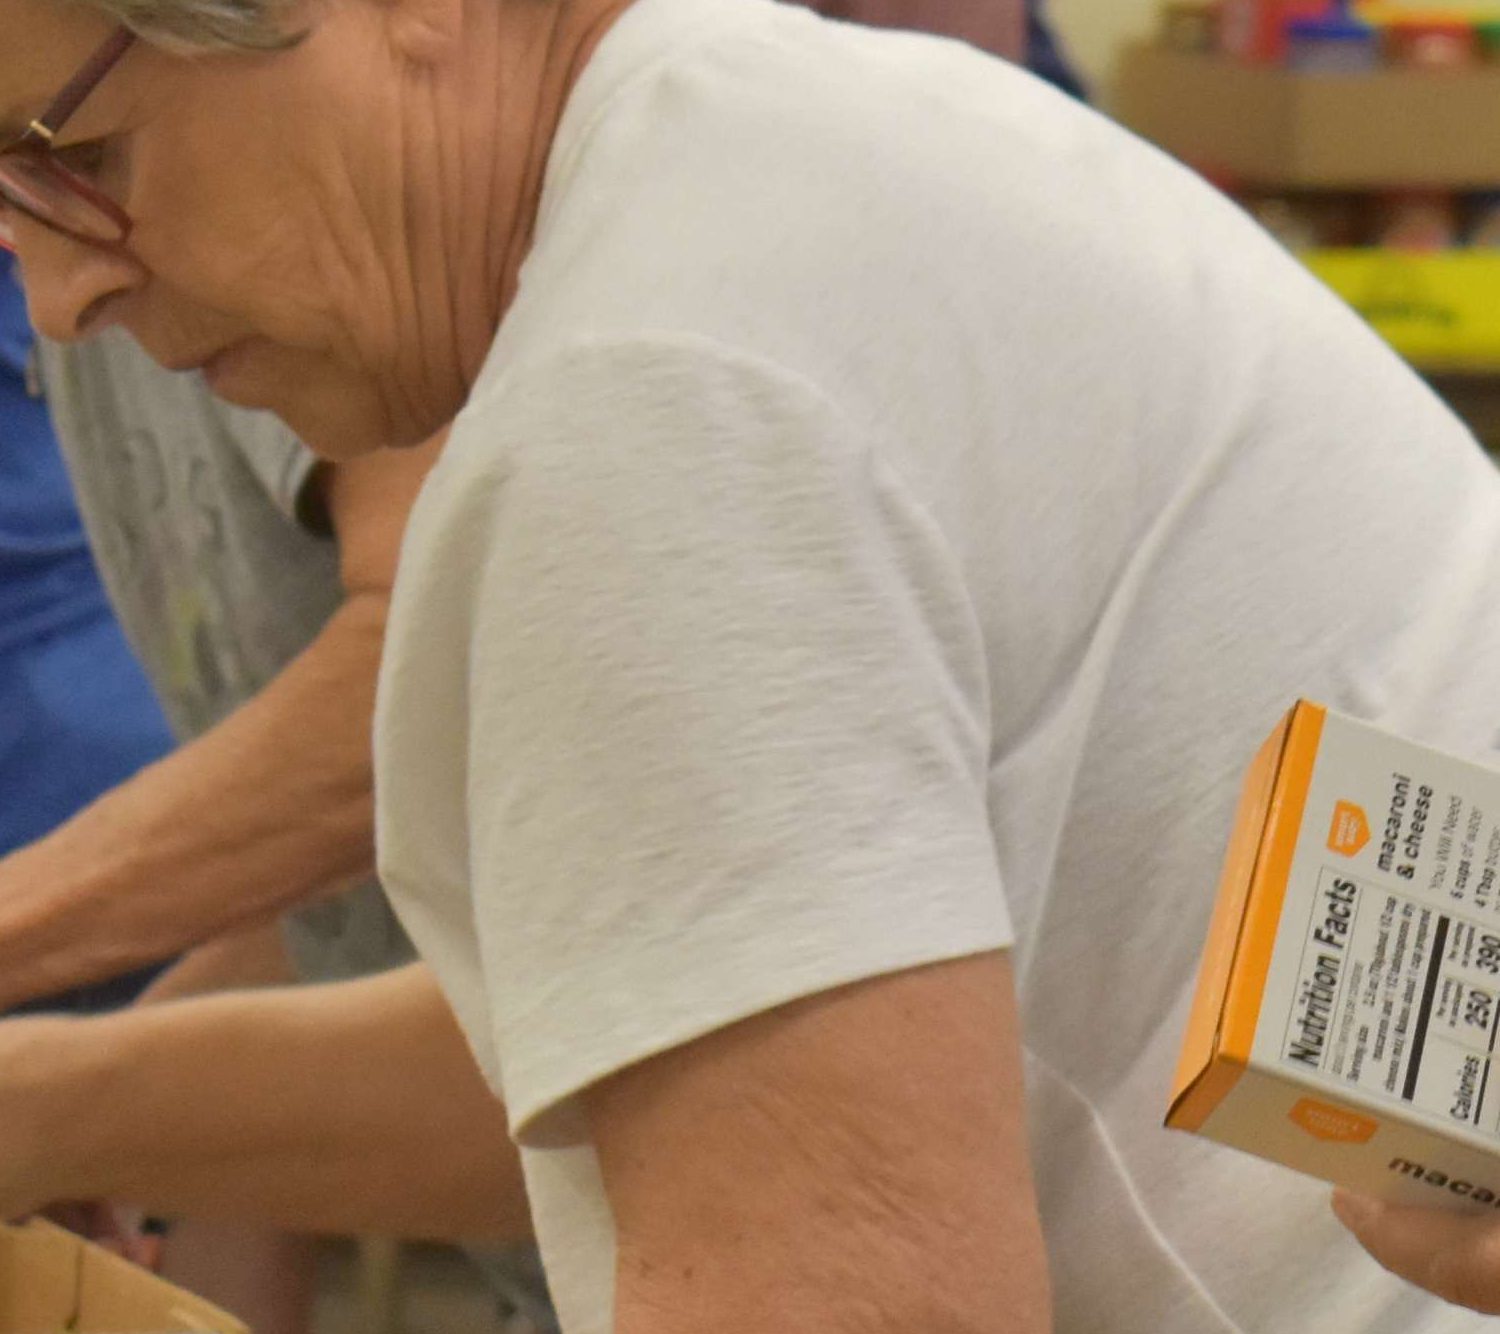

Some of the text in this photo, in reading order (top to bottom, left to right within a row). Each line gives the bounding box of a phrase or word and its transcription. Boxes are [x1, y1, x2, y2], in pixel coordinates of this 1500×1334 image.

[1372, 772, 1411, 872] macaroni
[1394, 783, 1434, 880] & cheese
[1312, 874, 1358, 950] Facts
[1286, 951, 1341, 1068] Nutrition
[1463, 987, 1493, 1029] 250
